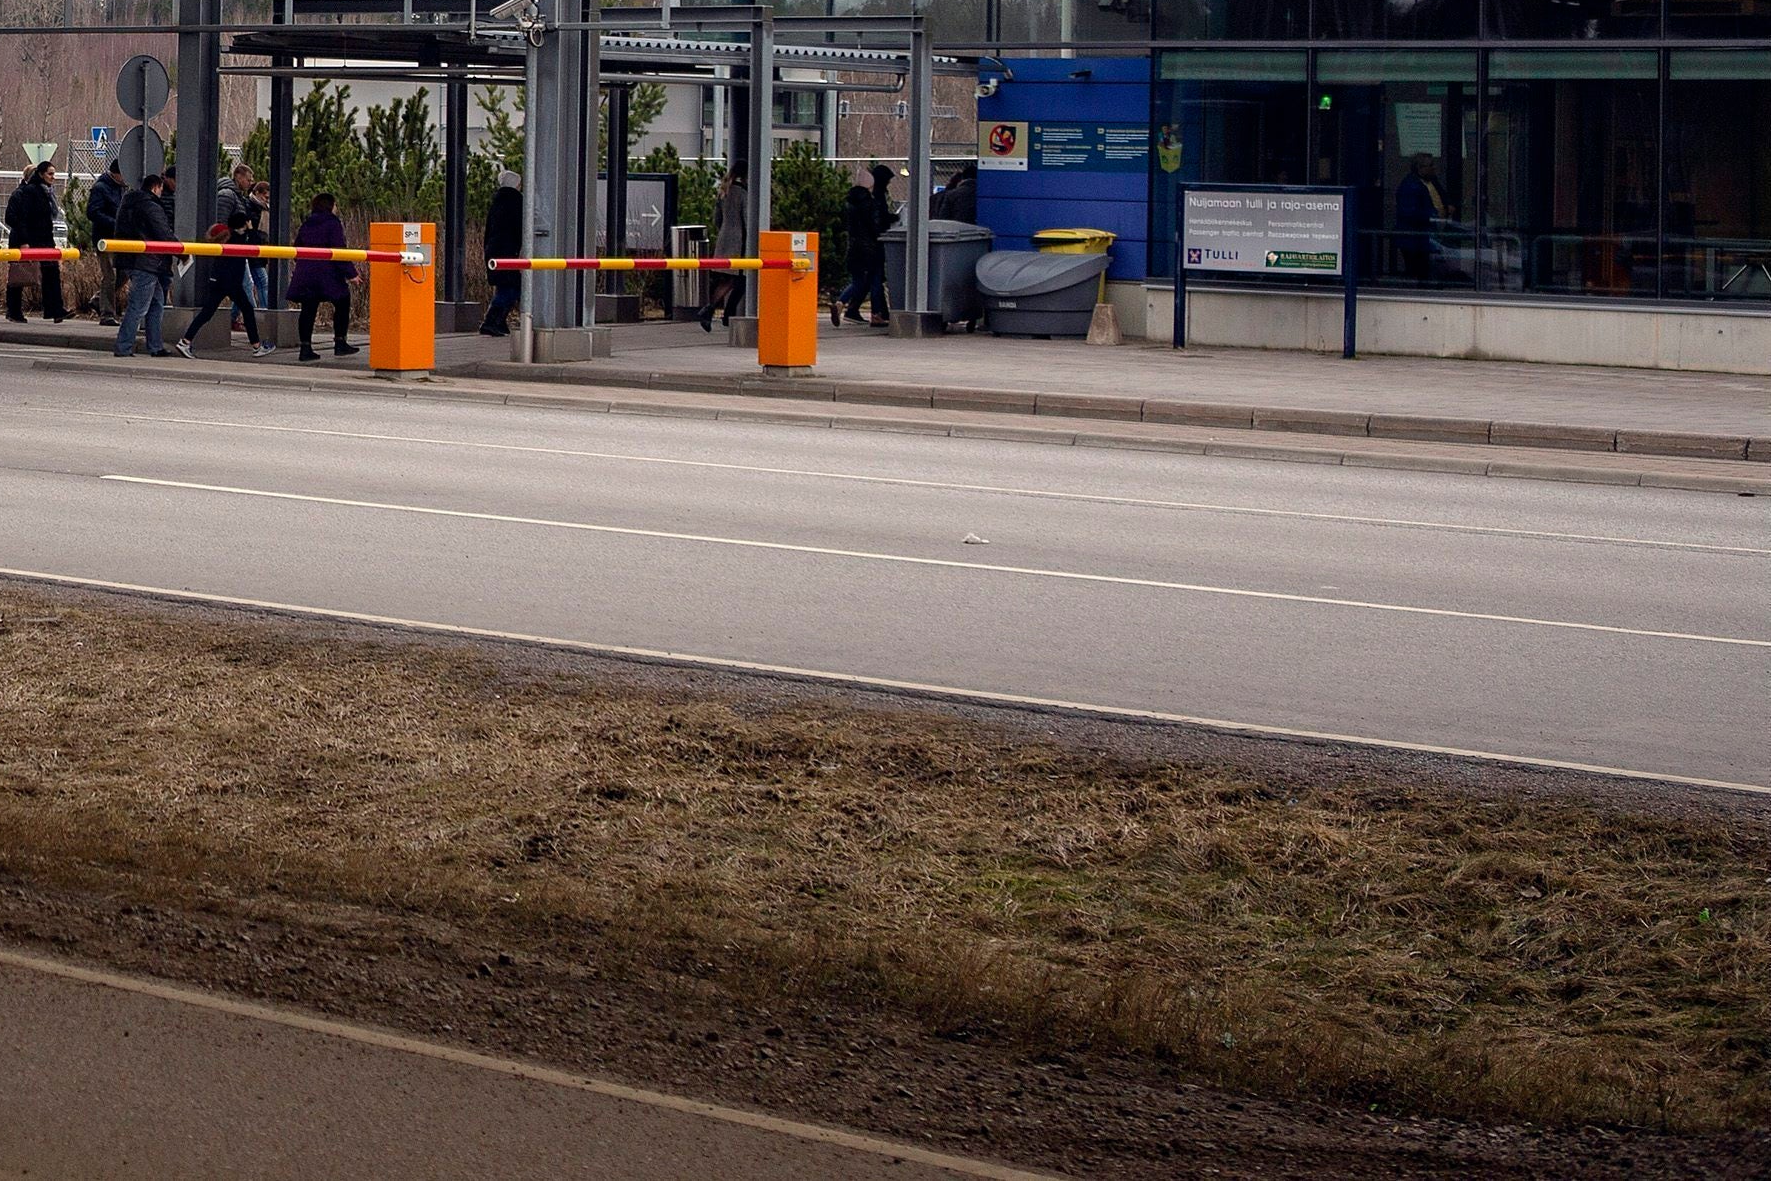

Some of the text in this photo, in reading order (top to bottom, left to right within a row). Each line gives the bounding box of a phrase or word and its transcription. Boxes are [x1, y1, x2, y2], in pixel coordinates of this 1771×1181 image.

[1189, 198, 1340, 212] Nuijamaan tulli ja raja-asema
[1204, 248, 1239, 261] TULLI
